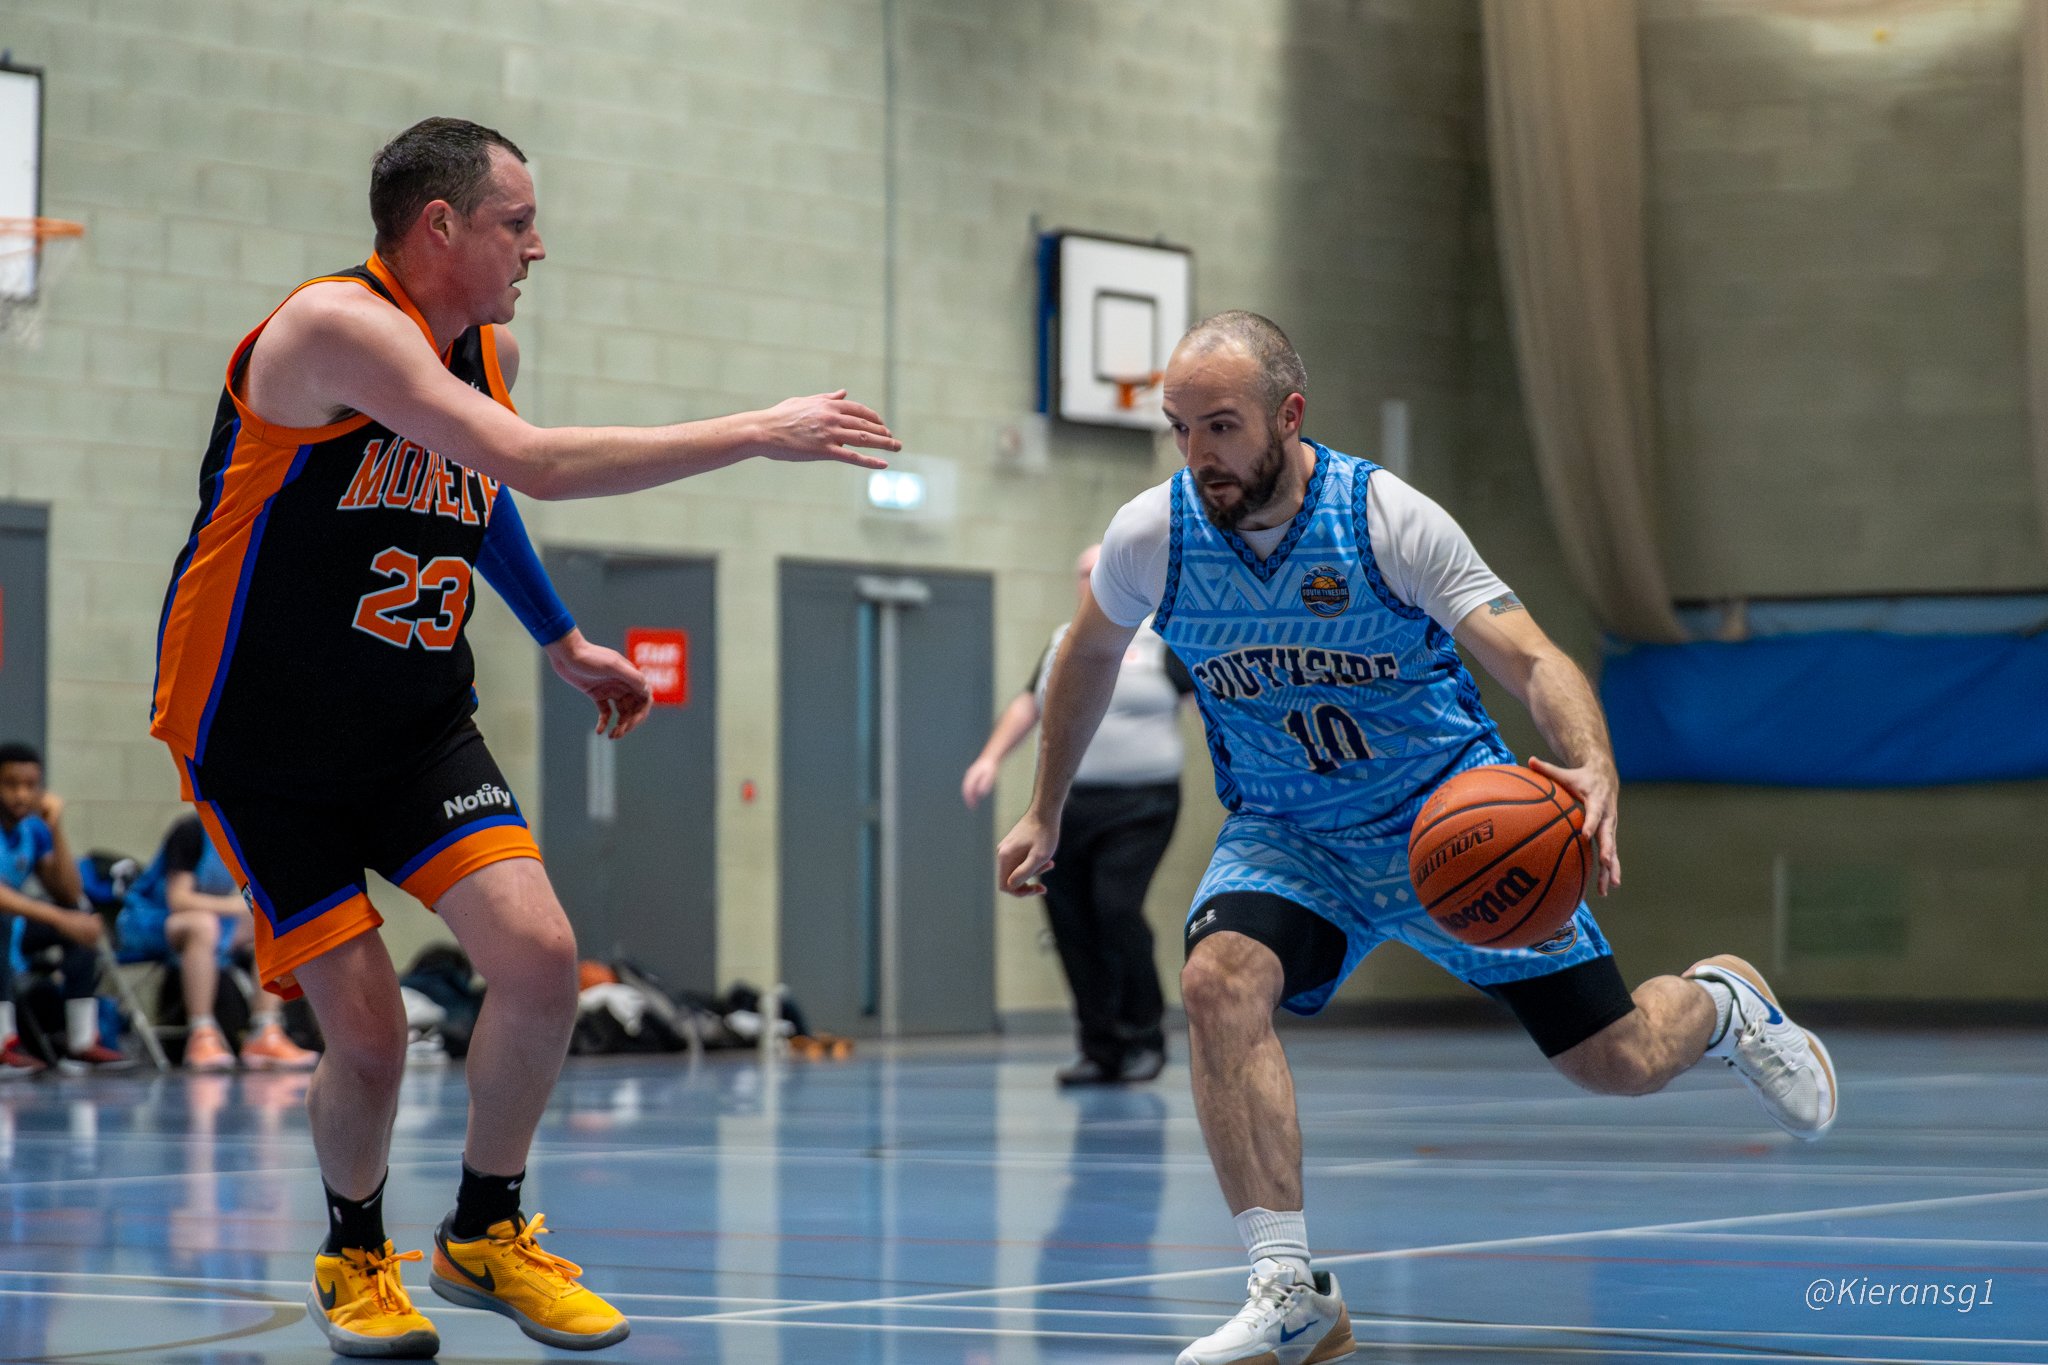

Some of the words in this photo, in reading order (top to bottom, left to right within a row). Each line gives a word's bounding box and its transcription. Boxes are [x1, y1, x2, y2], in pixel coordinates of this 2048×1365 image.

[352, 546, 472, 651] 23
[1283, 703, 1374, 774] 10
[443, 783, 511, 819] Notify
